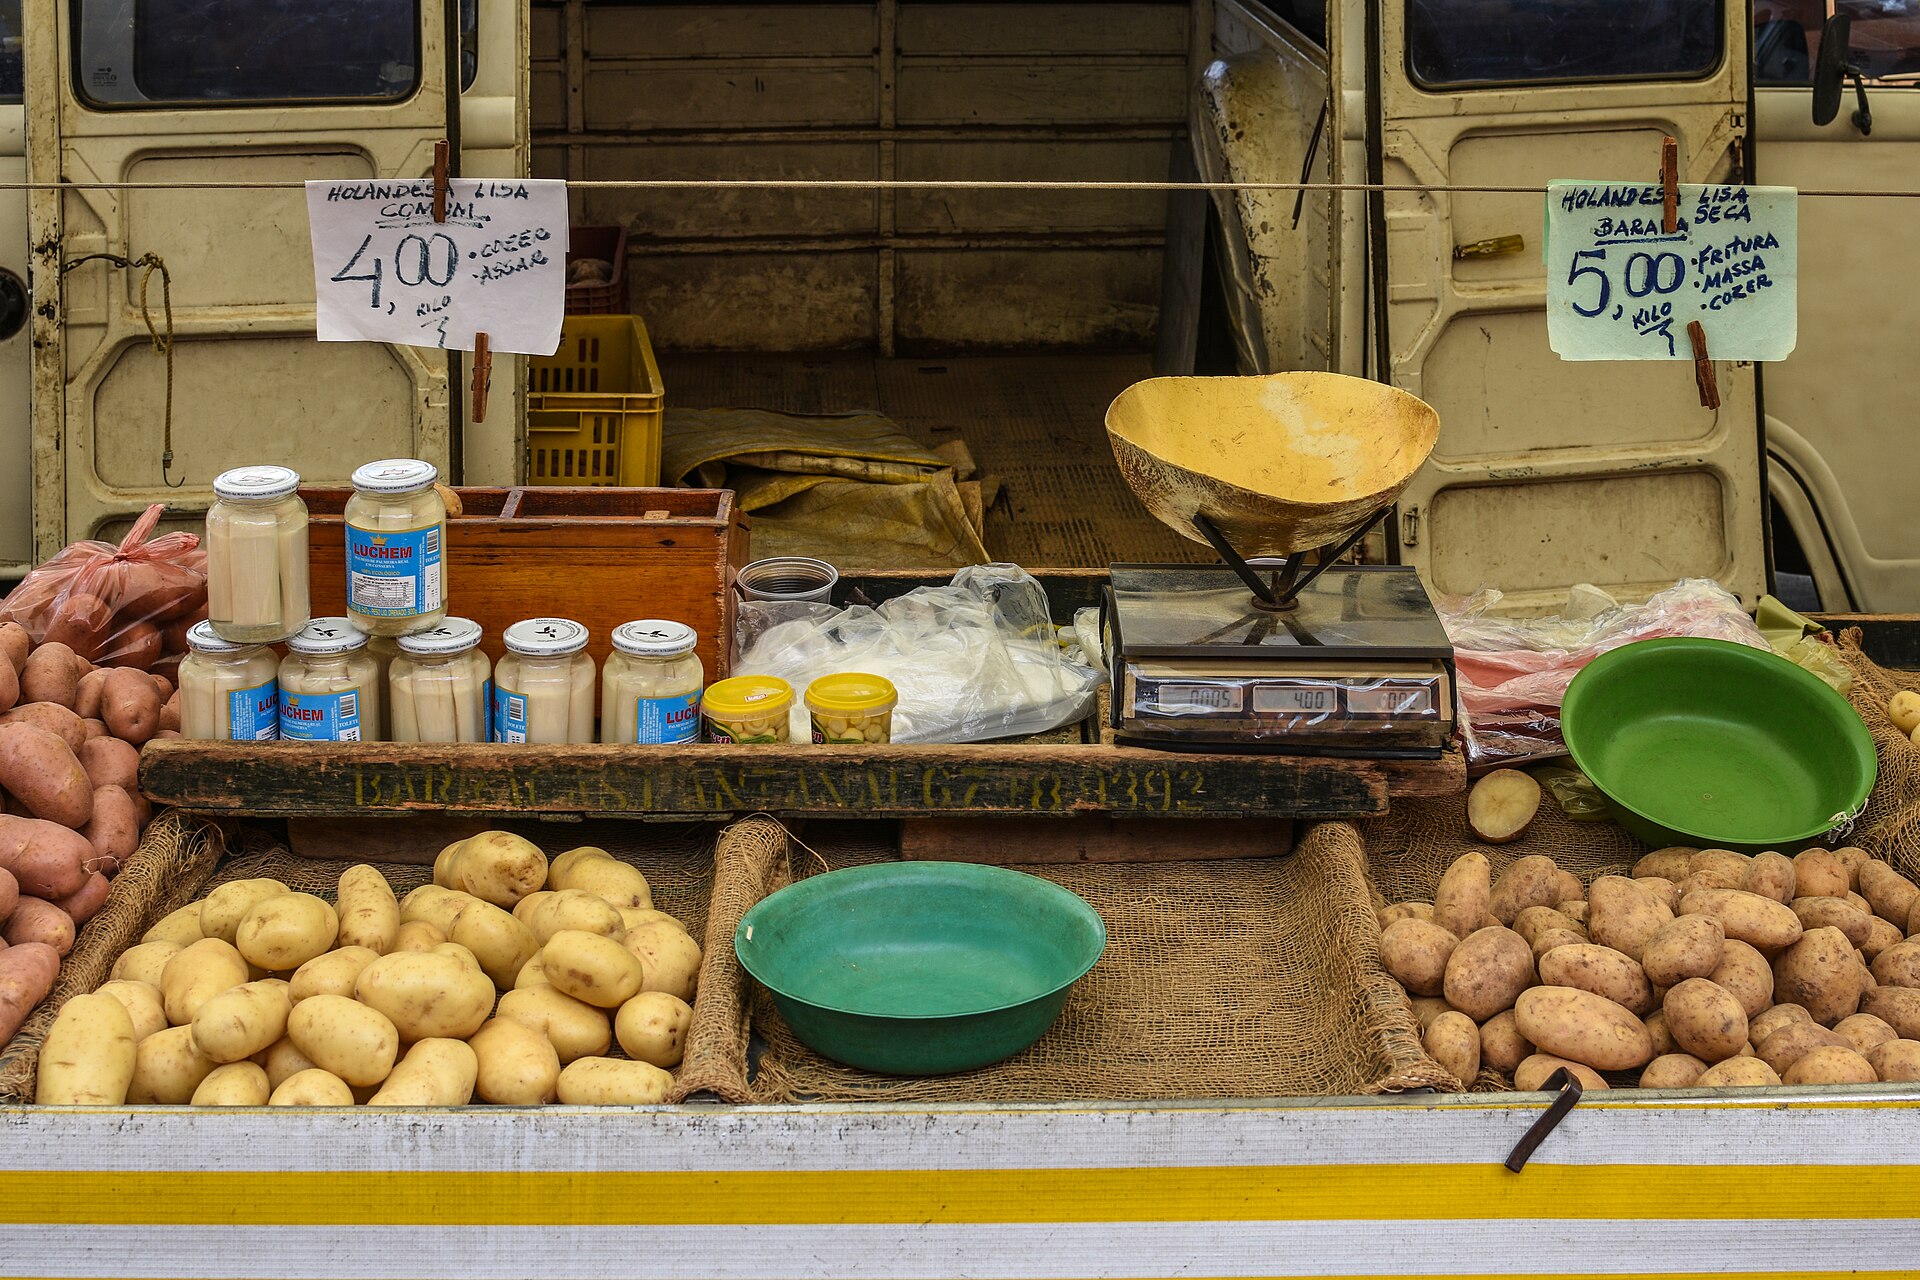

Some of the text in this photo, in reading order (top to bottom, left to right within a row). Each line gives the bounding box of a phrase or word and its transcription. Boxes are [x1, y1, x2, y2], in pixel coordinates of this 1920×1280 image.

[474, 182, 529, 200] LISA
[1698, 187, 1750, 205] LISA
[1694, 204, 1752, 225] SECA
[1594, 216, 1689, 238] BARAA
[1698, 232, 1780, 275] FRITURA
[330, 232, 459, 315] 4,00
[1568, 248, 1686, 321] 5,00
[1701, 255, 1766, 294] MASSA
[1708, 273, 1774, 311] COZER
[1632, 301, 1672, 330] KILO
[353, 543, 412, 559] LUCHEM
[258, 693, 278, 713] LUC
[665, 702, 700, 724] LUCH
